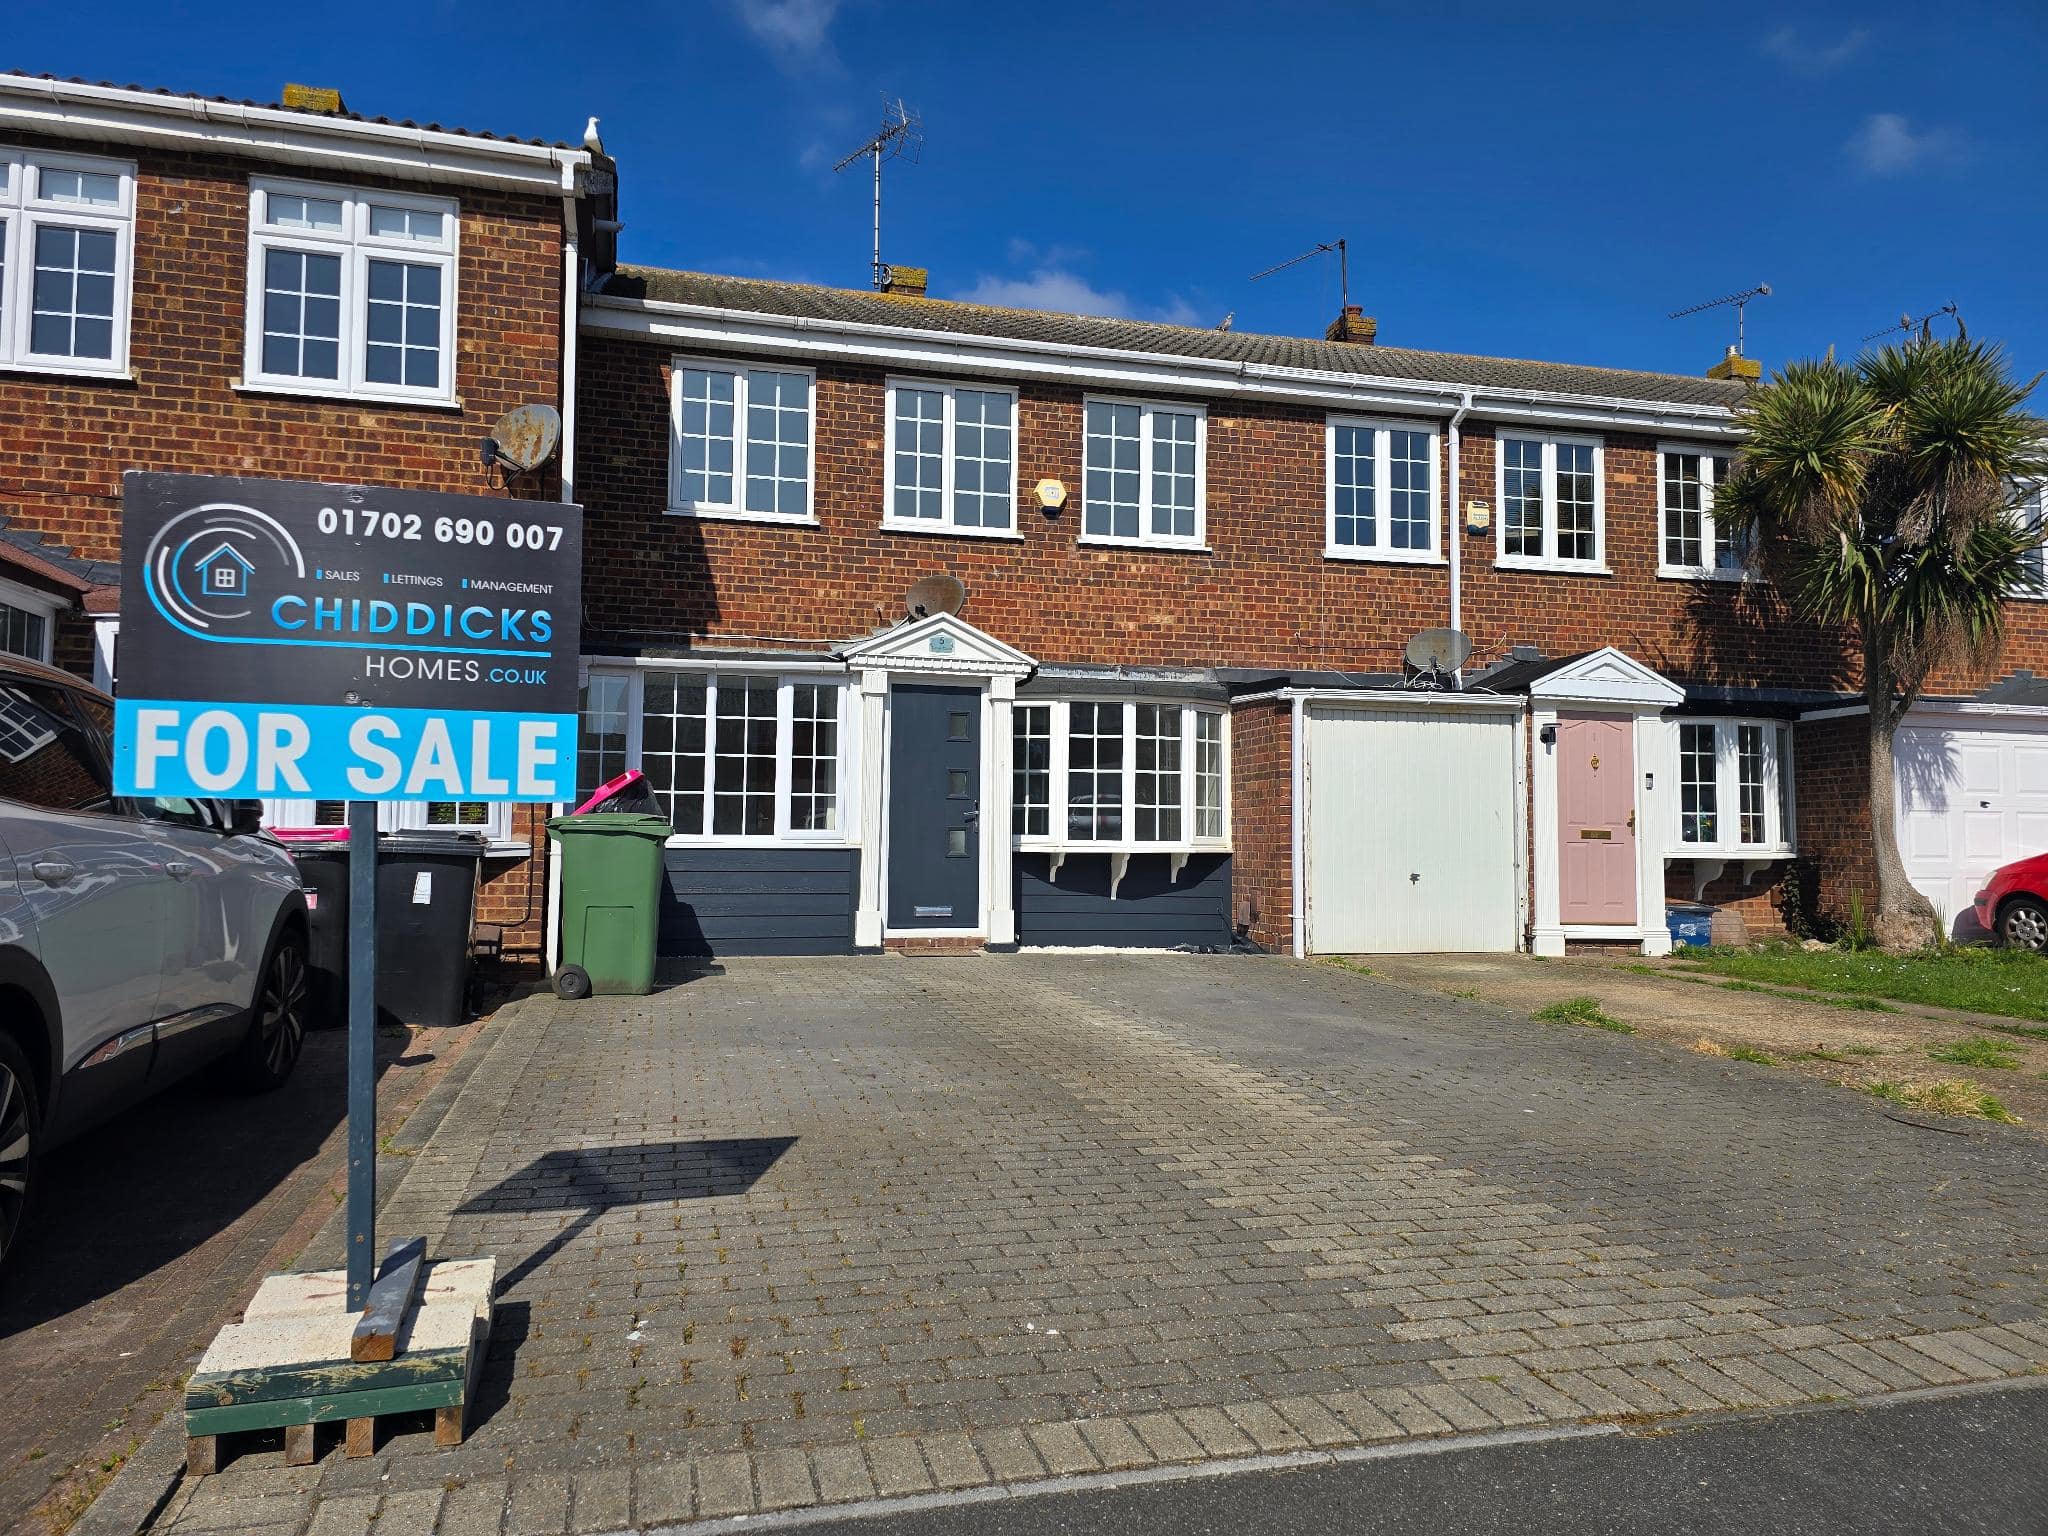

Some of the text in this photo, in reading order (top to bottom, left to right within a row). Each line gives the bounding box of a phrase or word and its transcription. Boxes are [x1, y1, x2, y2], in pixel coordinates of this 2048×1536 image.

[318, 507, 564, 551] 01702 690 007
[324, 569, 361, 582] SALES
[391, 573, 444, 588] LETTINGS
[470, 579, 555, 595] MANAGEMENT
[271, 595, 552, 643] CHIDDICKS
[134, 708, 558, 796] FOR SALE
